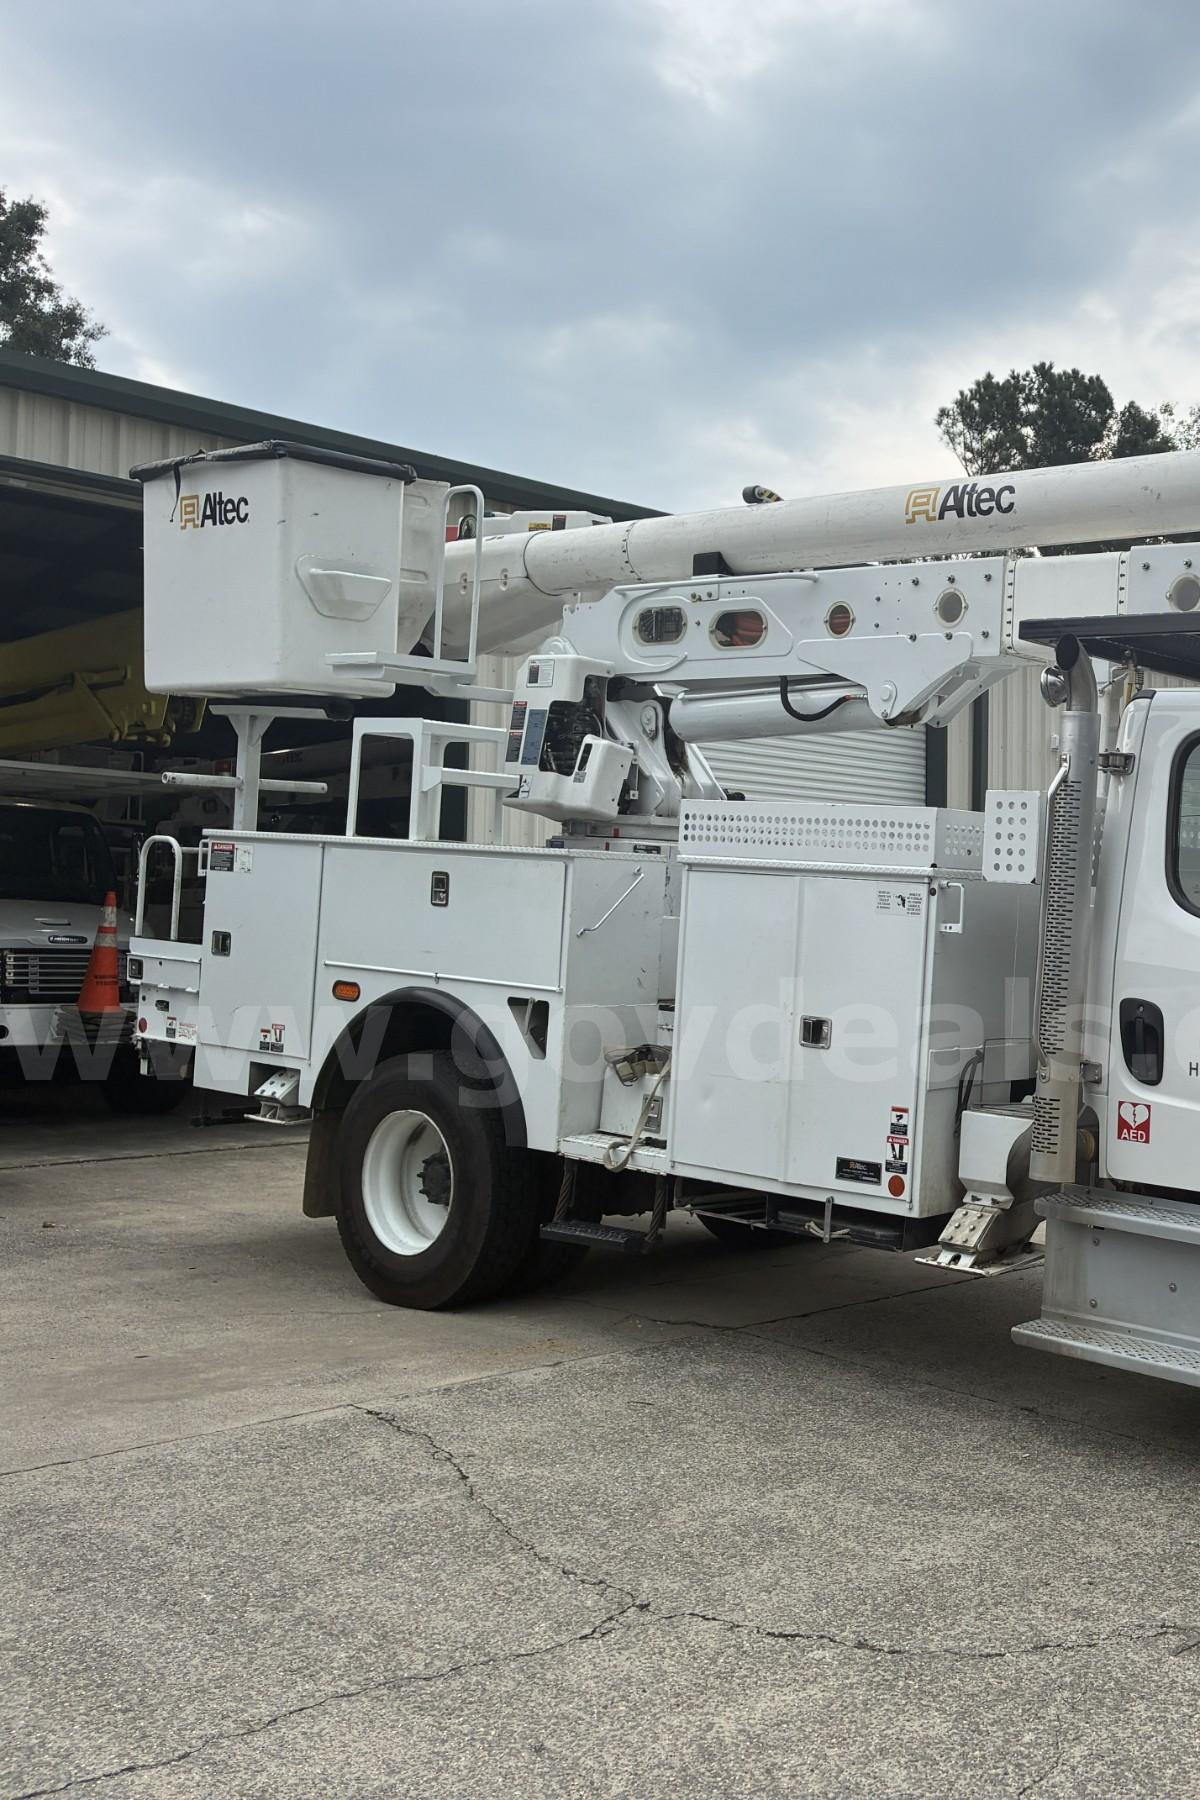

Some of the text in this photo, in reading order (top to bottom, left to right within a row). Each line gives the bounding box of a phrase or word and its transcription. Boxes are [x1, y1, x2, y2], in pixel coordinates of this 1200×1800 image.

[200, 491, 249, 527] Altec
[938, 483, 1015, 520] Altec
[1120, 1128, 1146, 1142] AED
